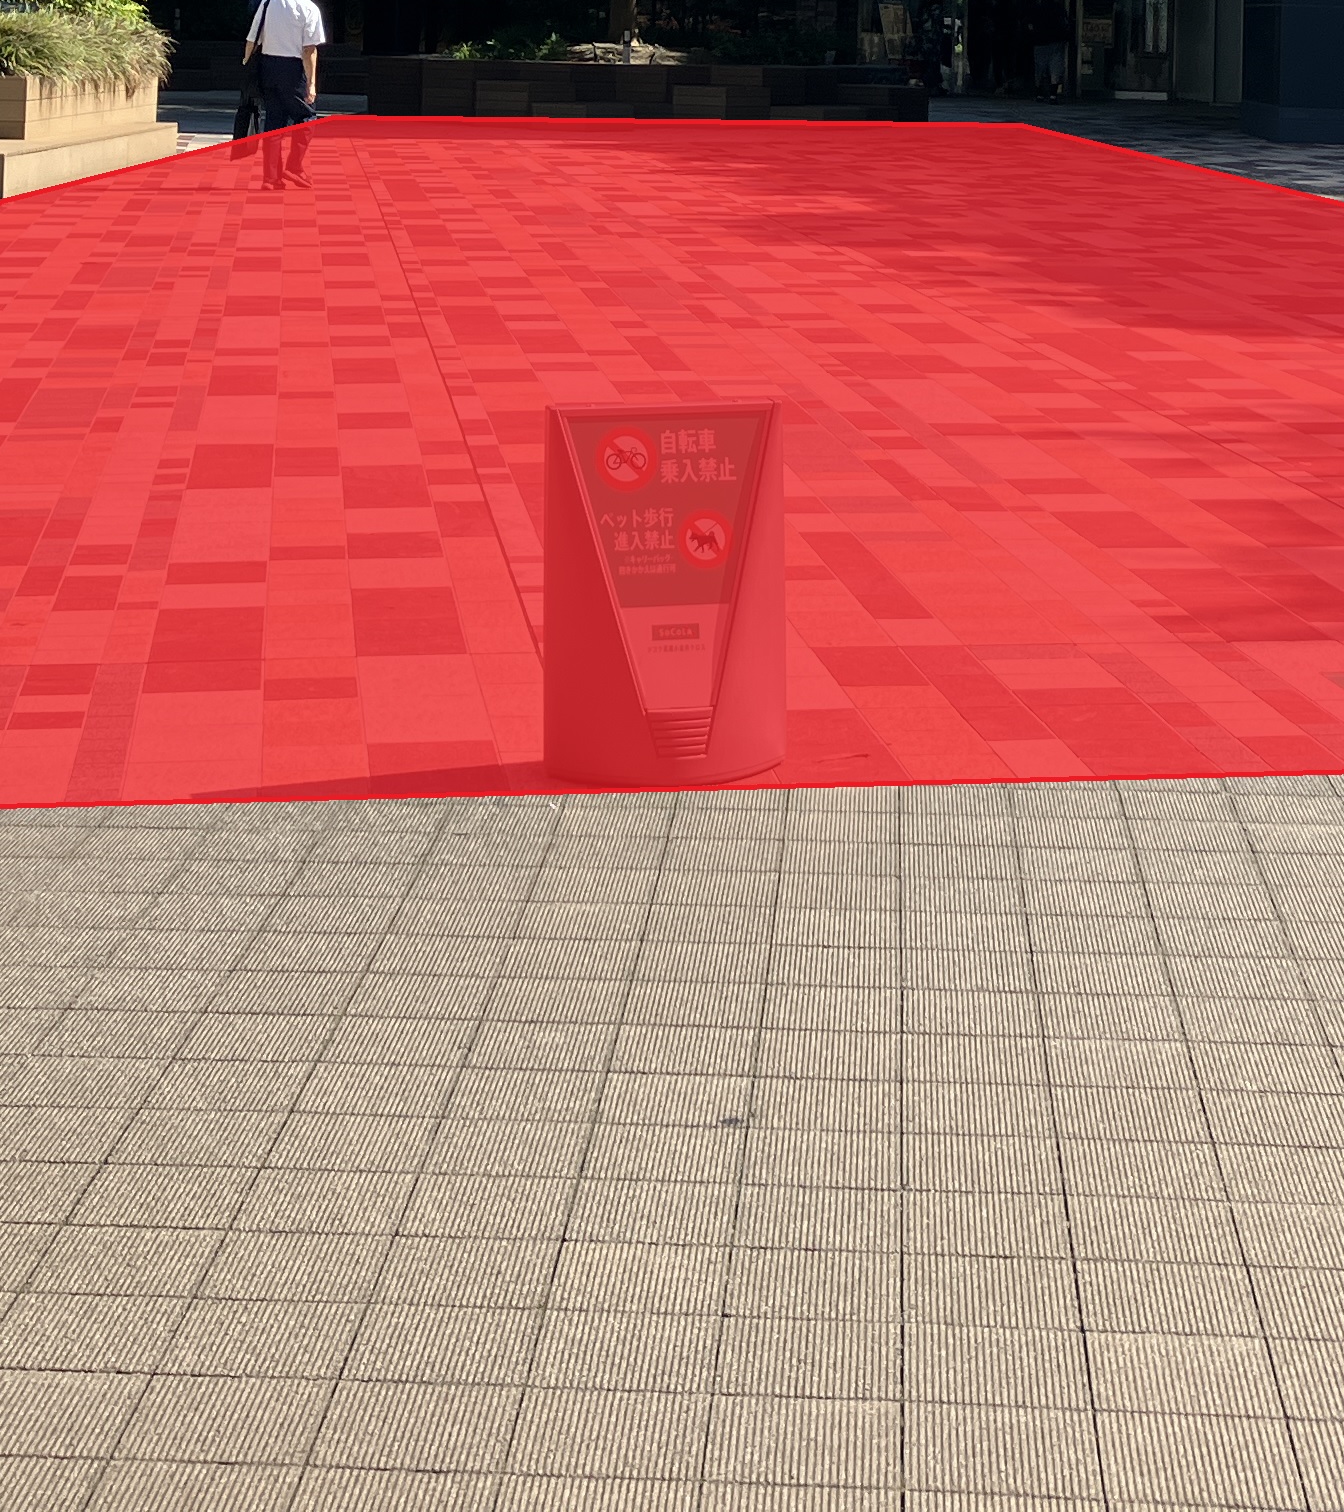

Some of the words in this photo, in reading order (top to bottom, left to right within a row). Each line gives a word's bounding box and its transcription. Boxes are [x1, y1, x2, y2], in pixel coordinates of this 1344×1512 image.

[660, 428, 717, 454] 自転車
[660, 457, 737, 484] 乗入禁止
[600, 507, 675, 529] ペット歩行
[613, 530, 676, 551] 進入禁止
